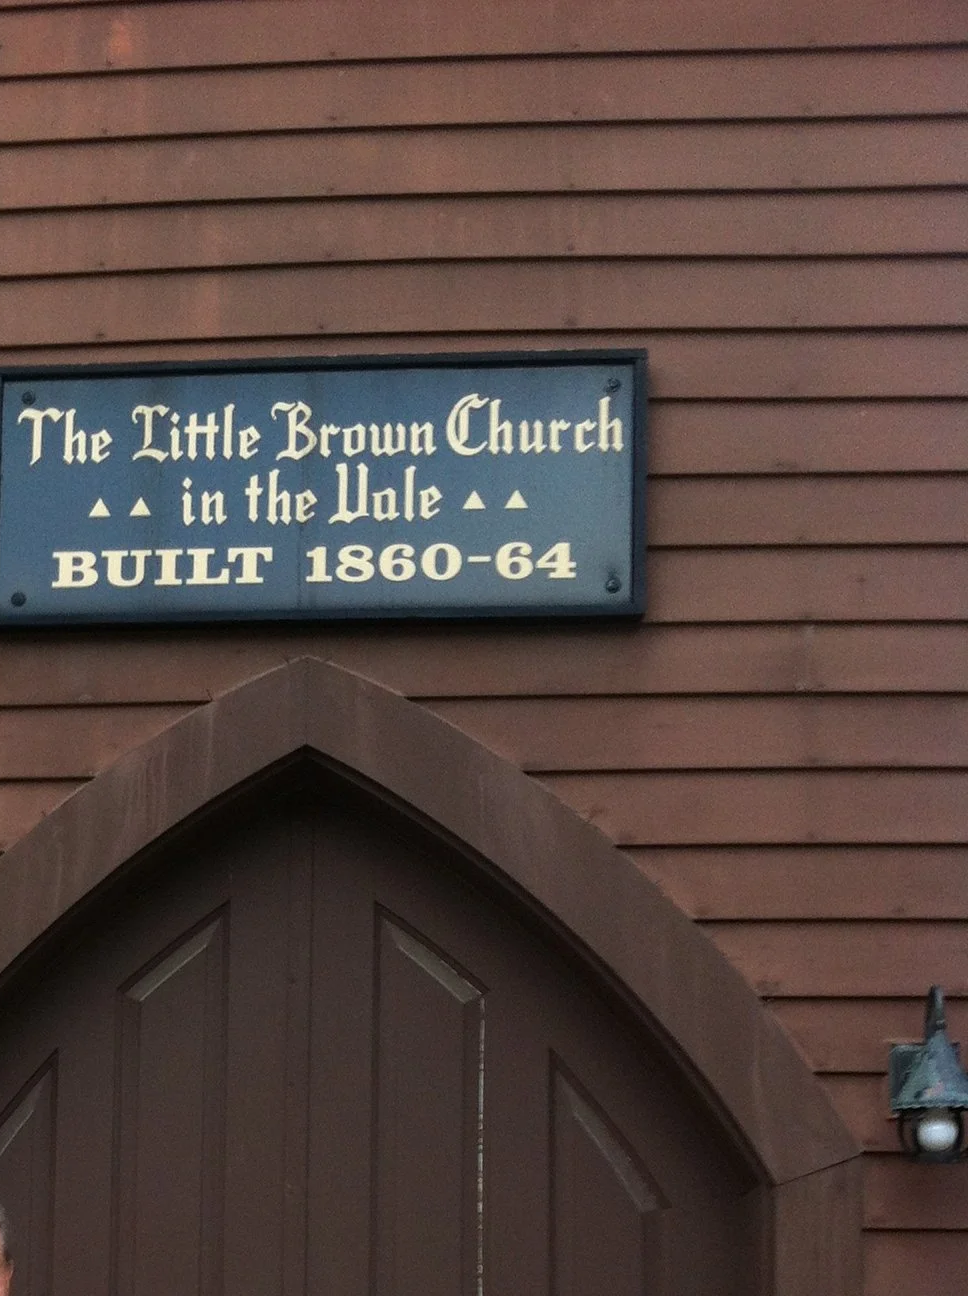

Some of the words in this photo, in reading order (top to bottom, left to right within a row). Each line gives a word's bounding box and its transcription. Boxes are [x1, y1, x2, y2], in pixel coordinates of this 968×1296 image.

[17, 407, 113, 466] The
[131, 403, 261, 463] Little
[271, 401, 437, 461] Brown
[445, 392, 625, 456] Church
[182, 477, 228, 527] in
[245, 468, 318, 525] the
[328, 462, 443, 525] Vale
[51, 547, 273, 589] BUILT
[304, 542, 577, 583] 1860-64
